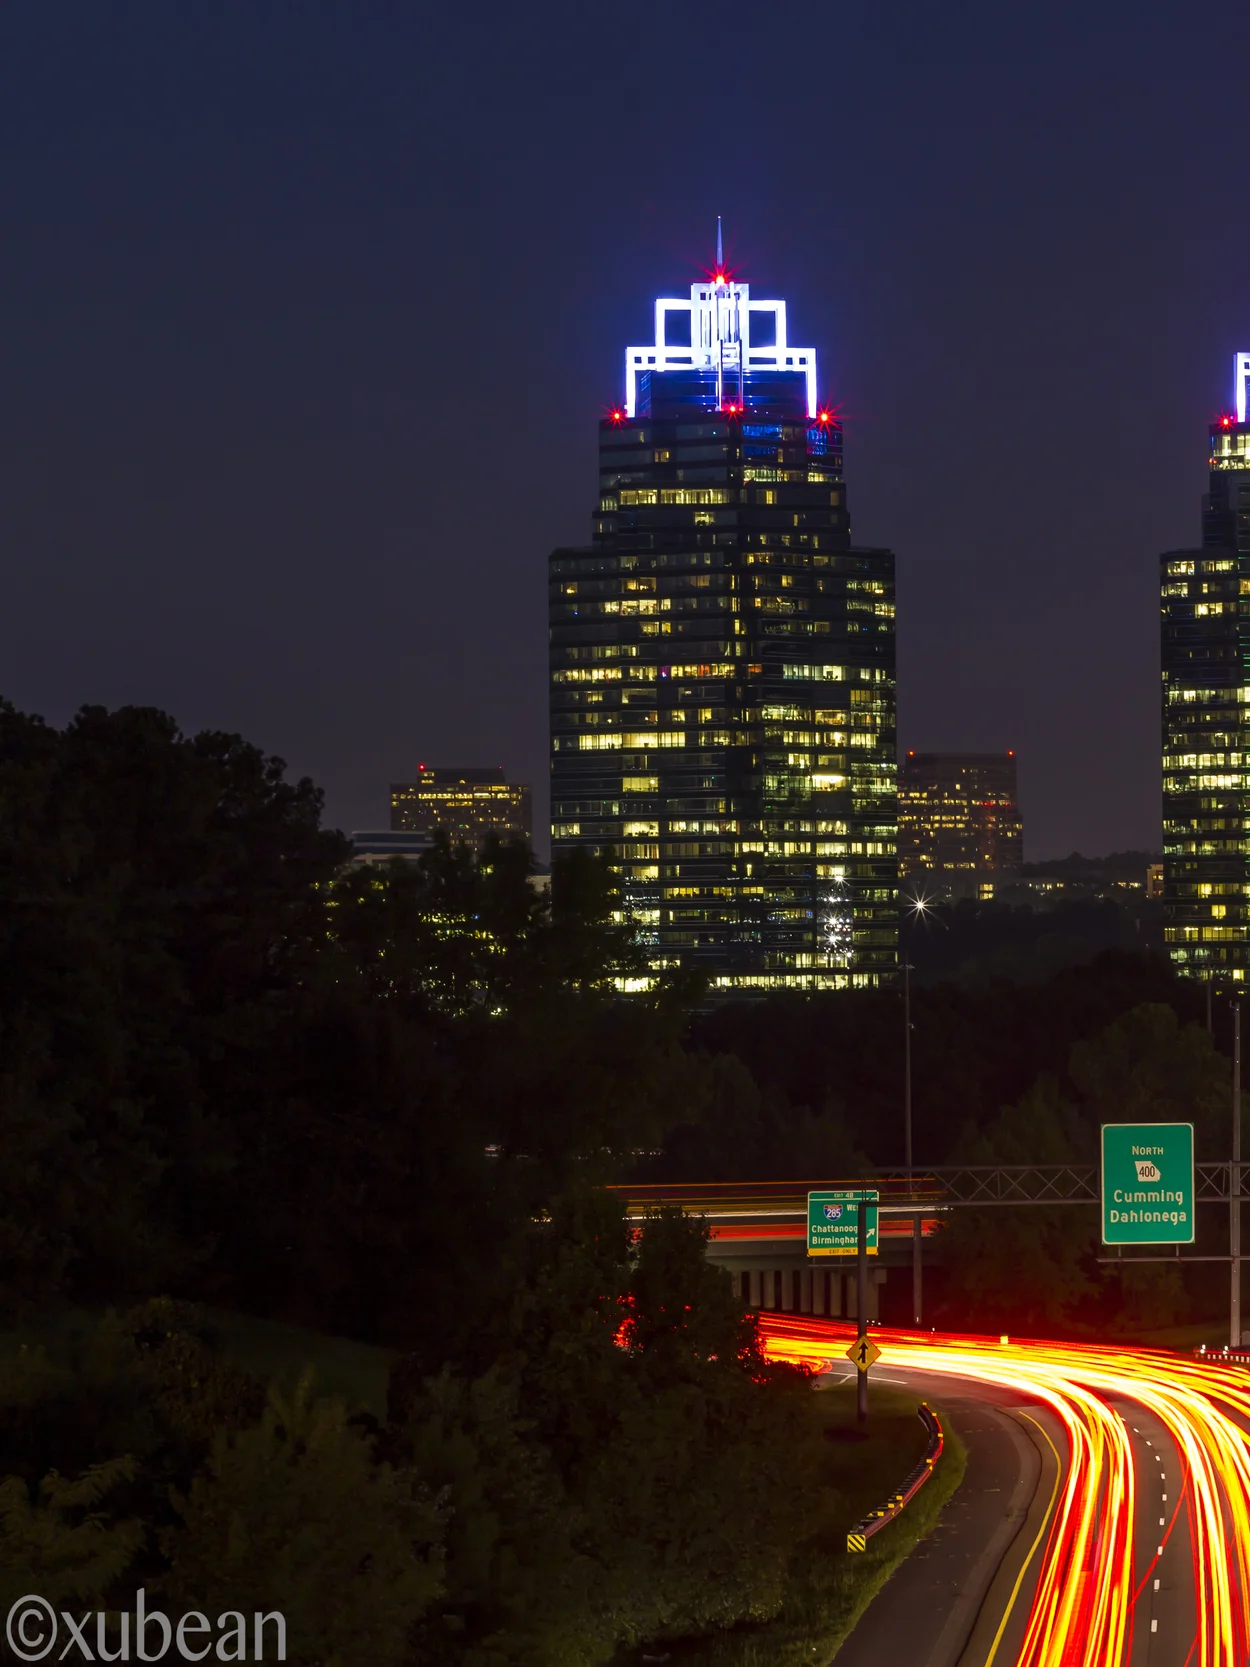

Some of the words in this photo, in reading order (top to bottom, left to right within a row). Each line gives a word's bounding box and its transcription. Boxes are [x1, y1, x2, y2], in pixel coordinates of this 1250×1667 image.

[1132, 1146, 1164, 1155] NORTH
[1139, 1166, 1155, 1177] 400
[1114, 1190, 1183, 1205] Cumming
[827, 1209, 840, 1217] 285
[1110, 1210, 1187, 1226] Dahlonega
[812, 1225, 858, 1234] Chattanoog
